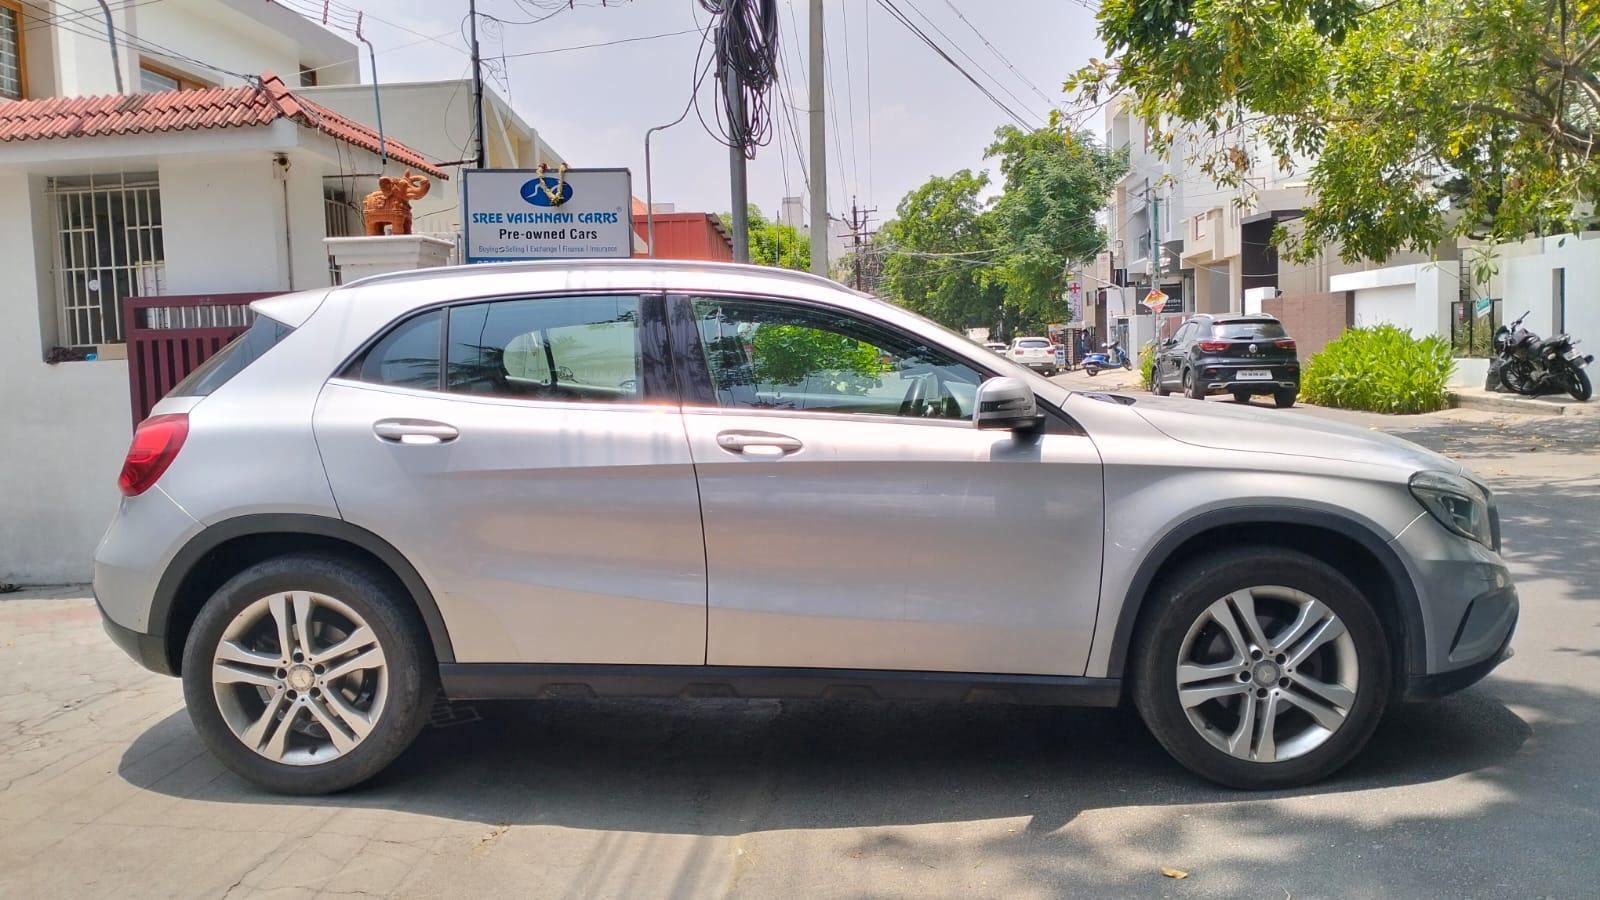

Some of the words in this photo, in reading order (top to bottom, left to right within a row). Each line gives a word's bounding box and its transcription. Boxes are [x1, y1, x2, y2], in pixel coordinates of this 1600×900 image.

[472, 212, 503, 224] SREE
[506, 212, 574, 225] VAISHNAVI
[577, 212, 618, 225] CARRS
[499, 228, 565, 240] Pre-owned
[569, 228, 598, 240] Cars
[478, 245, 499, 254] Buying
[505, 245, 525, 254] Selling
[529, 245, 558, 253] Exchange
[562, 245, 584, 253] Finance
